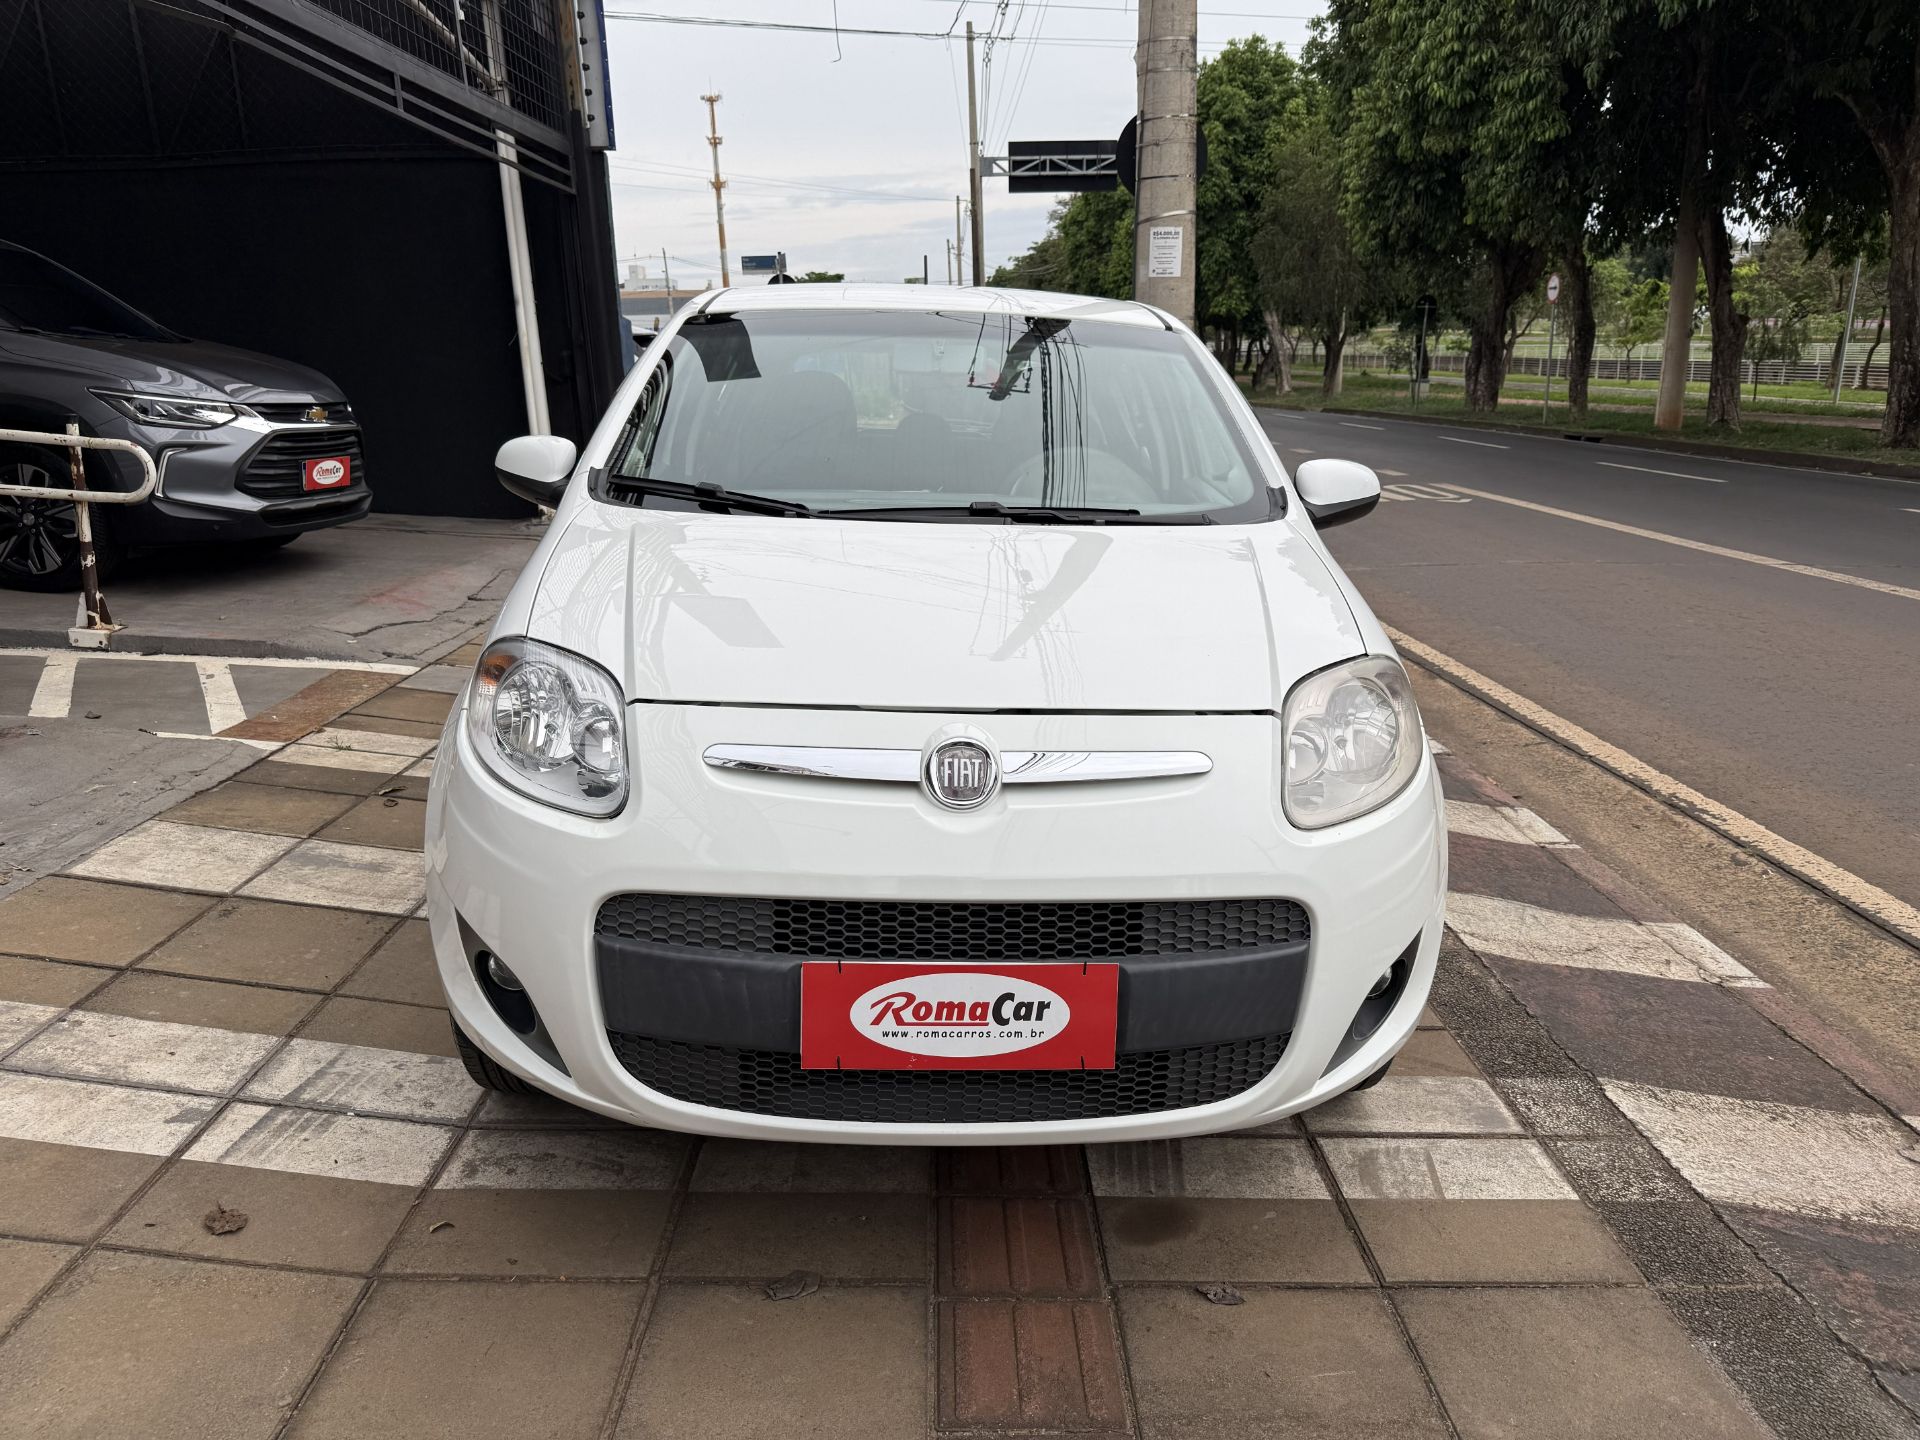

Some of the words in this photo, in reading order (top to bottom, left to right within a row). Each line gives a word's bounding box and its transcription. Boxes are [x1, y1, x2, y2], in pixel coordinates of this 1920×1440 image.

[944, 758, 982, 787] FIAT
[870, 991, 1051, 1026] RomaCar
[881, 1028, 1045, 1039] www.romacarros.com.br
